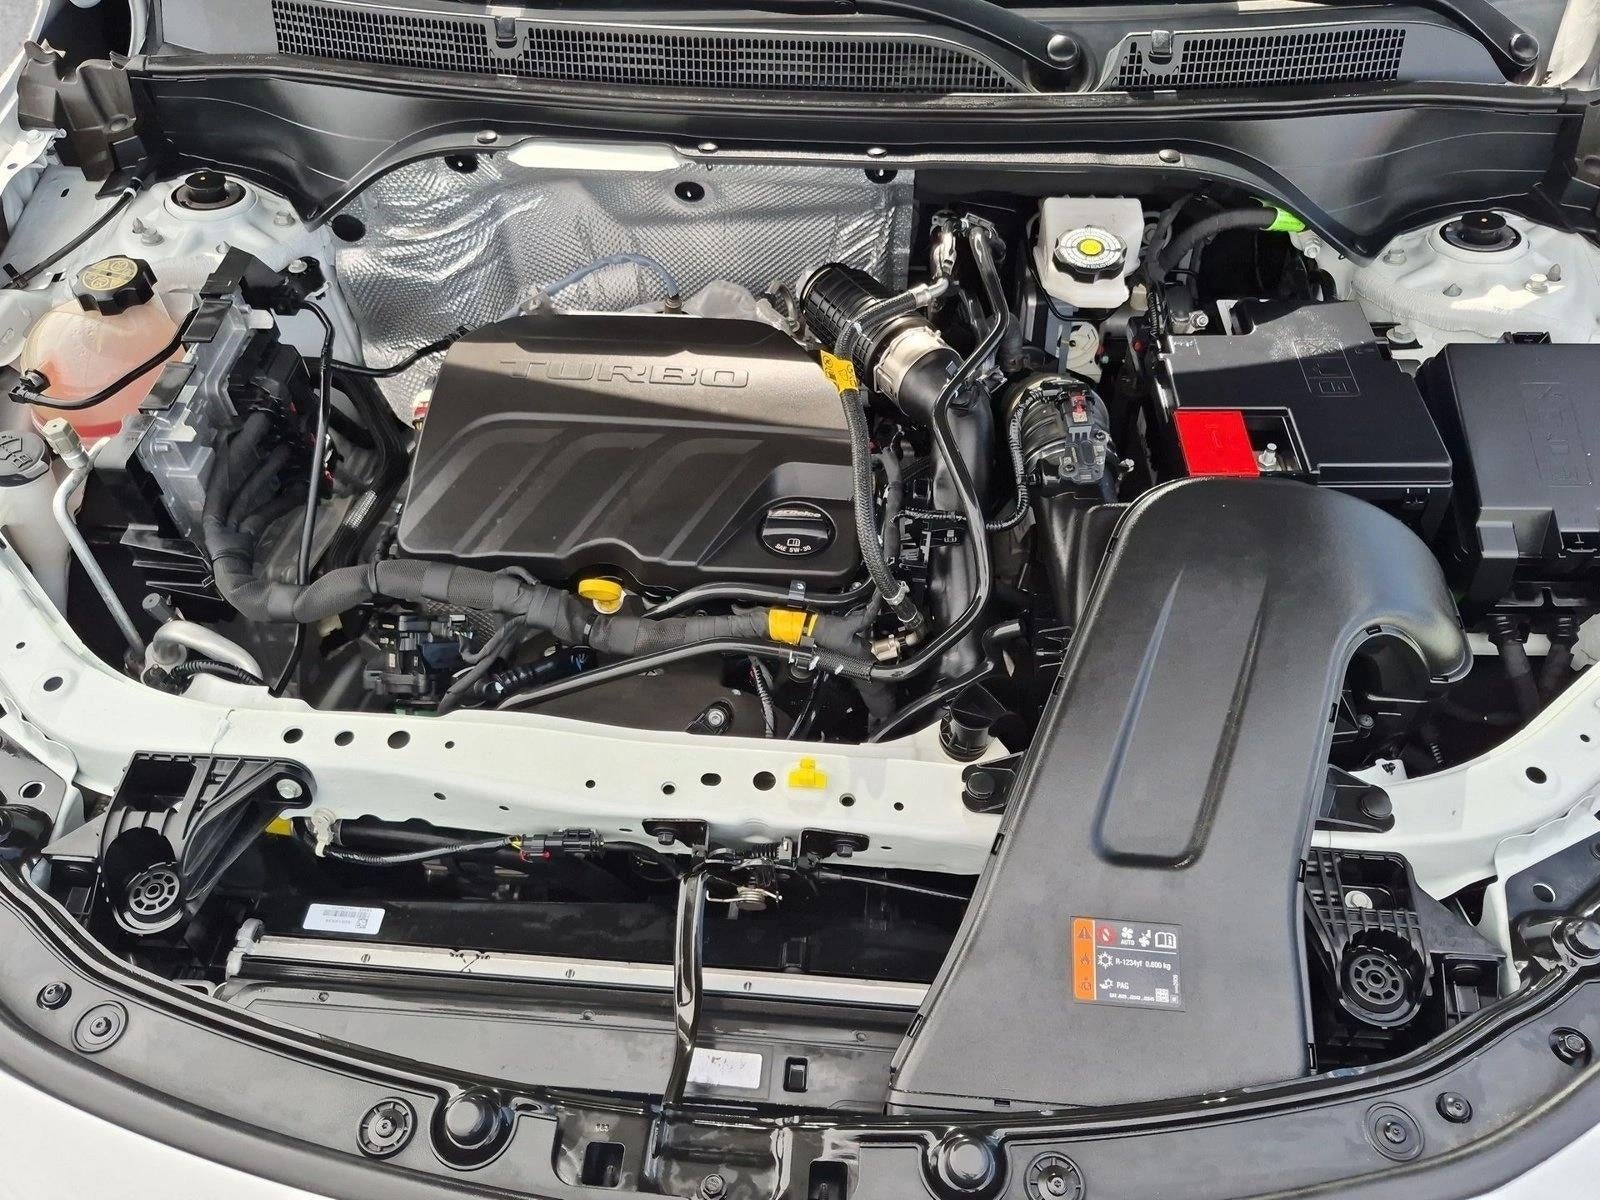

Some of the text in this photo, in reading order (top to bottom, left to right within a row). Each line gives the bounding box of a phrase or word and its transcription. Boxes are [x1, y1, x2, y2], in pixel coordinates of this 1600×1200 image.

[500, 361, 750, 388] TURBO
[774, 543, 787, 552] SAE
[1163, 962, 1172, 970] kg
[1116, 981, 1129, 989] PAG
